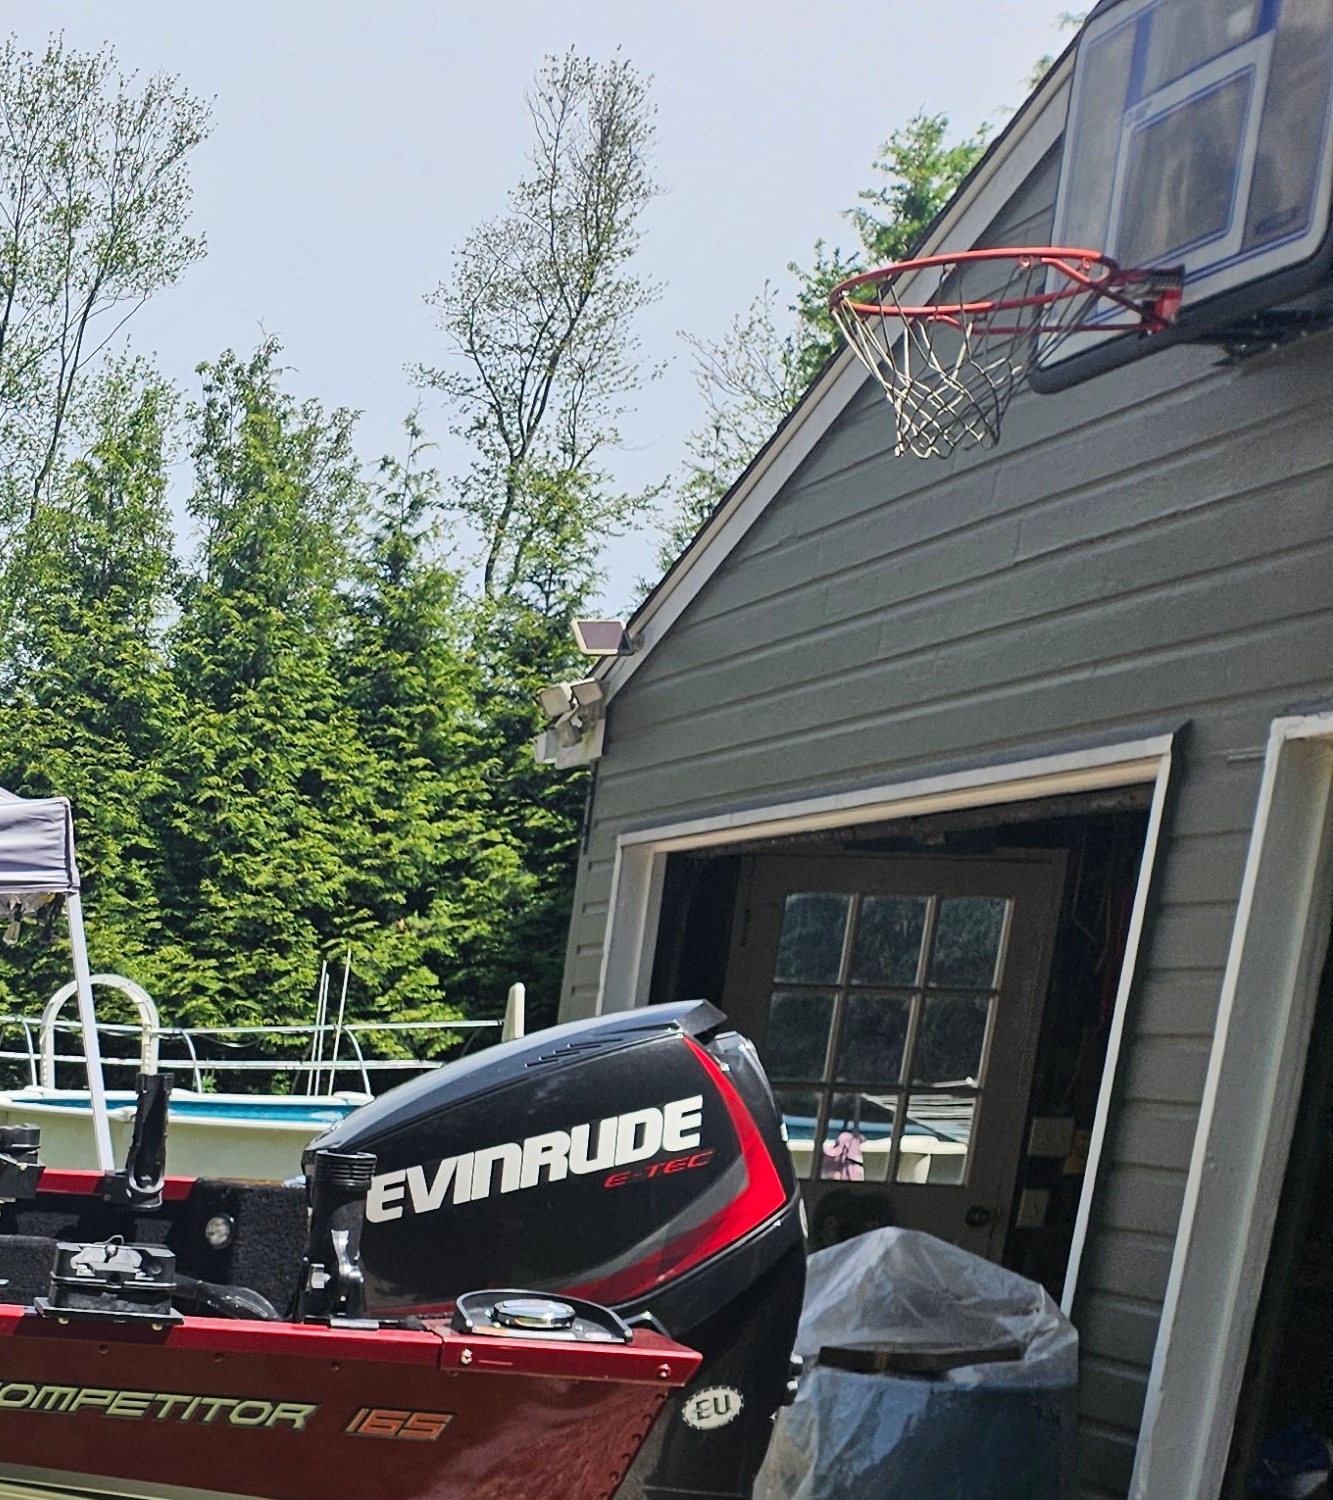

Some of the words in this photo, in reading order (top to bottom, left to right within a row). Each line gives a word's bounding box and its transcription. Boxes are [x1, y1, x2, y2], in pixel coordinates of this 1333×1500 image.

[365, 1094, 704, 1224] EVINRUDE
[602, 1150, 716, 1190] E-TEC
[343, 1407, 458, 1440] 165
